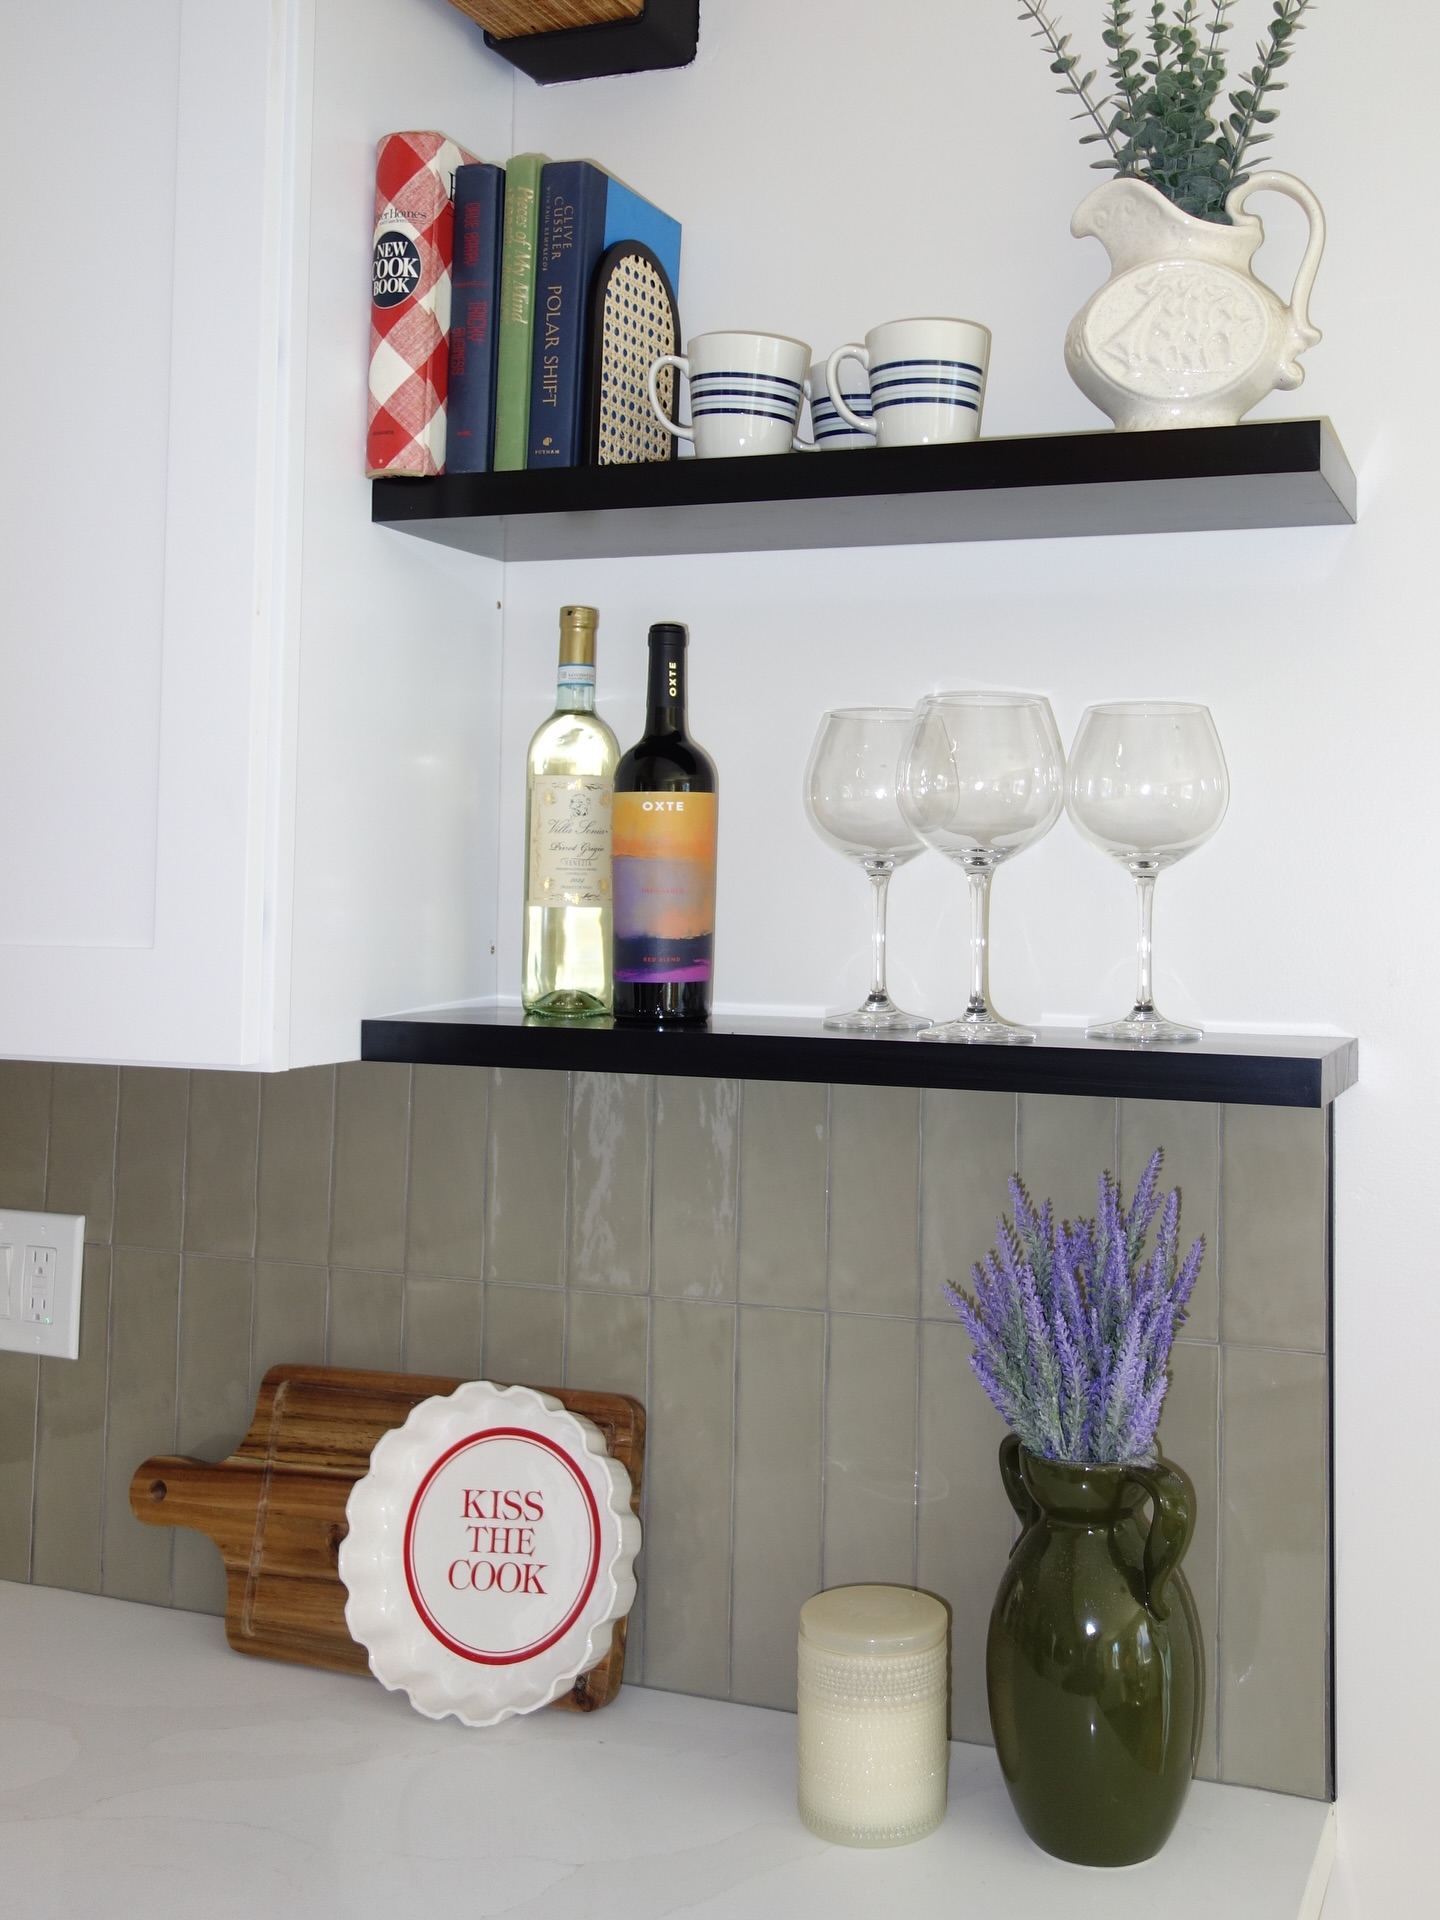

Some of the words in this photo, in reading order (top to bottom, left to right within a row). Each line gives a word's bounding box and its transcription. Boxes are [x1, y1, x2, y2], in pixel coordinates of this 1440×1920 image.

[516, 187, 534, 228] Pieces
[516, 231, 532, 251] of
[551, 196, 564, 260] CUSSLER
[562, 205, 574, 249] CLIVE
[377, 241, 408, 260] NEW
[514, 250, 531, 277] My
[372, 257, 419, 282] COOK
[373, 278, 410, 297] BOOK
[511, 280, 529, 325] Mind
[544, 285, 562, 350] POLAR
[542, 355, 559, 407] SHIFT
[669, 662, 677, 697] OXTE
[642, 801, 684, 811] OXTE
[548, 819, 573, 834] Villa
[549, 842, 577, 852] Pinot
[460, 1489, 544, 1522] KISS
[465, 1525, 536, 1557] THE
[448, 1559, 548, 1595] COOK
